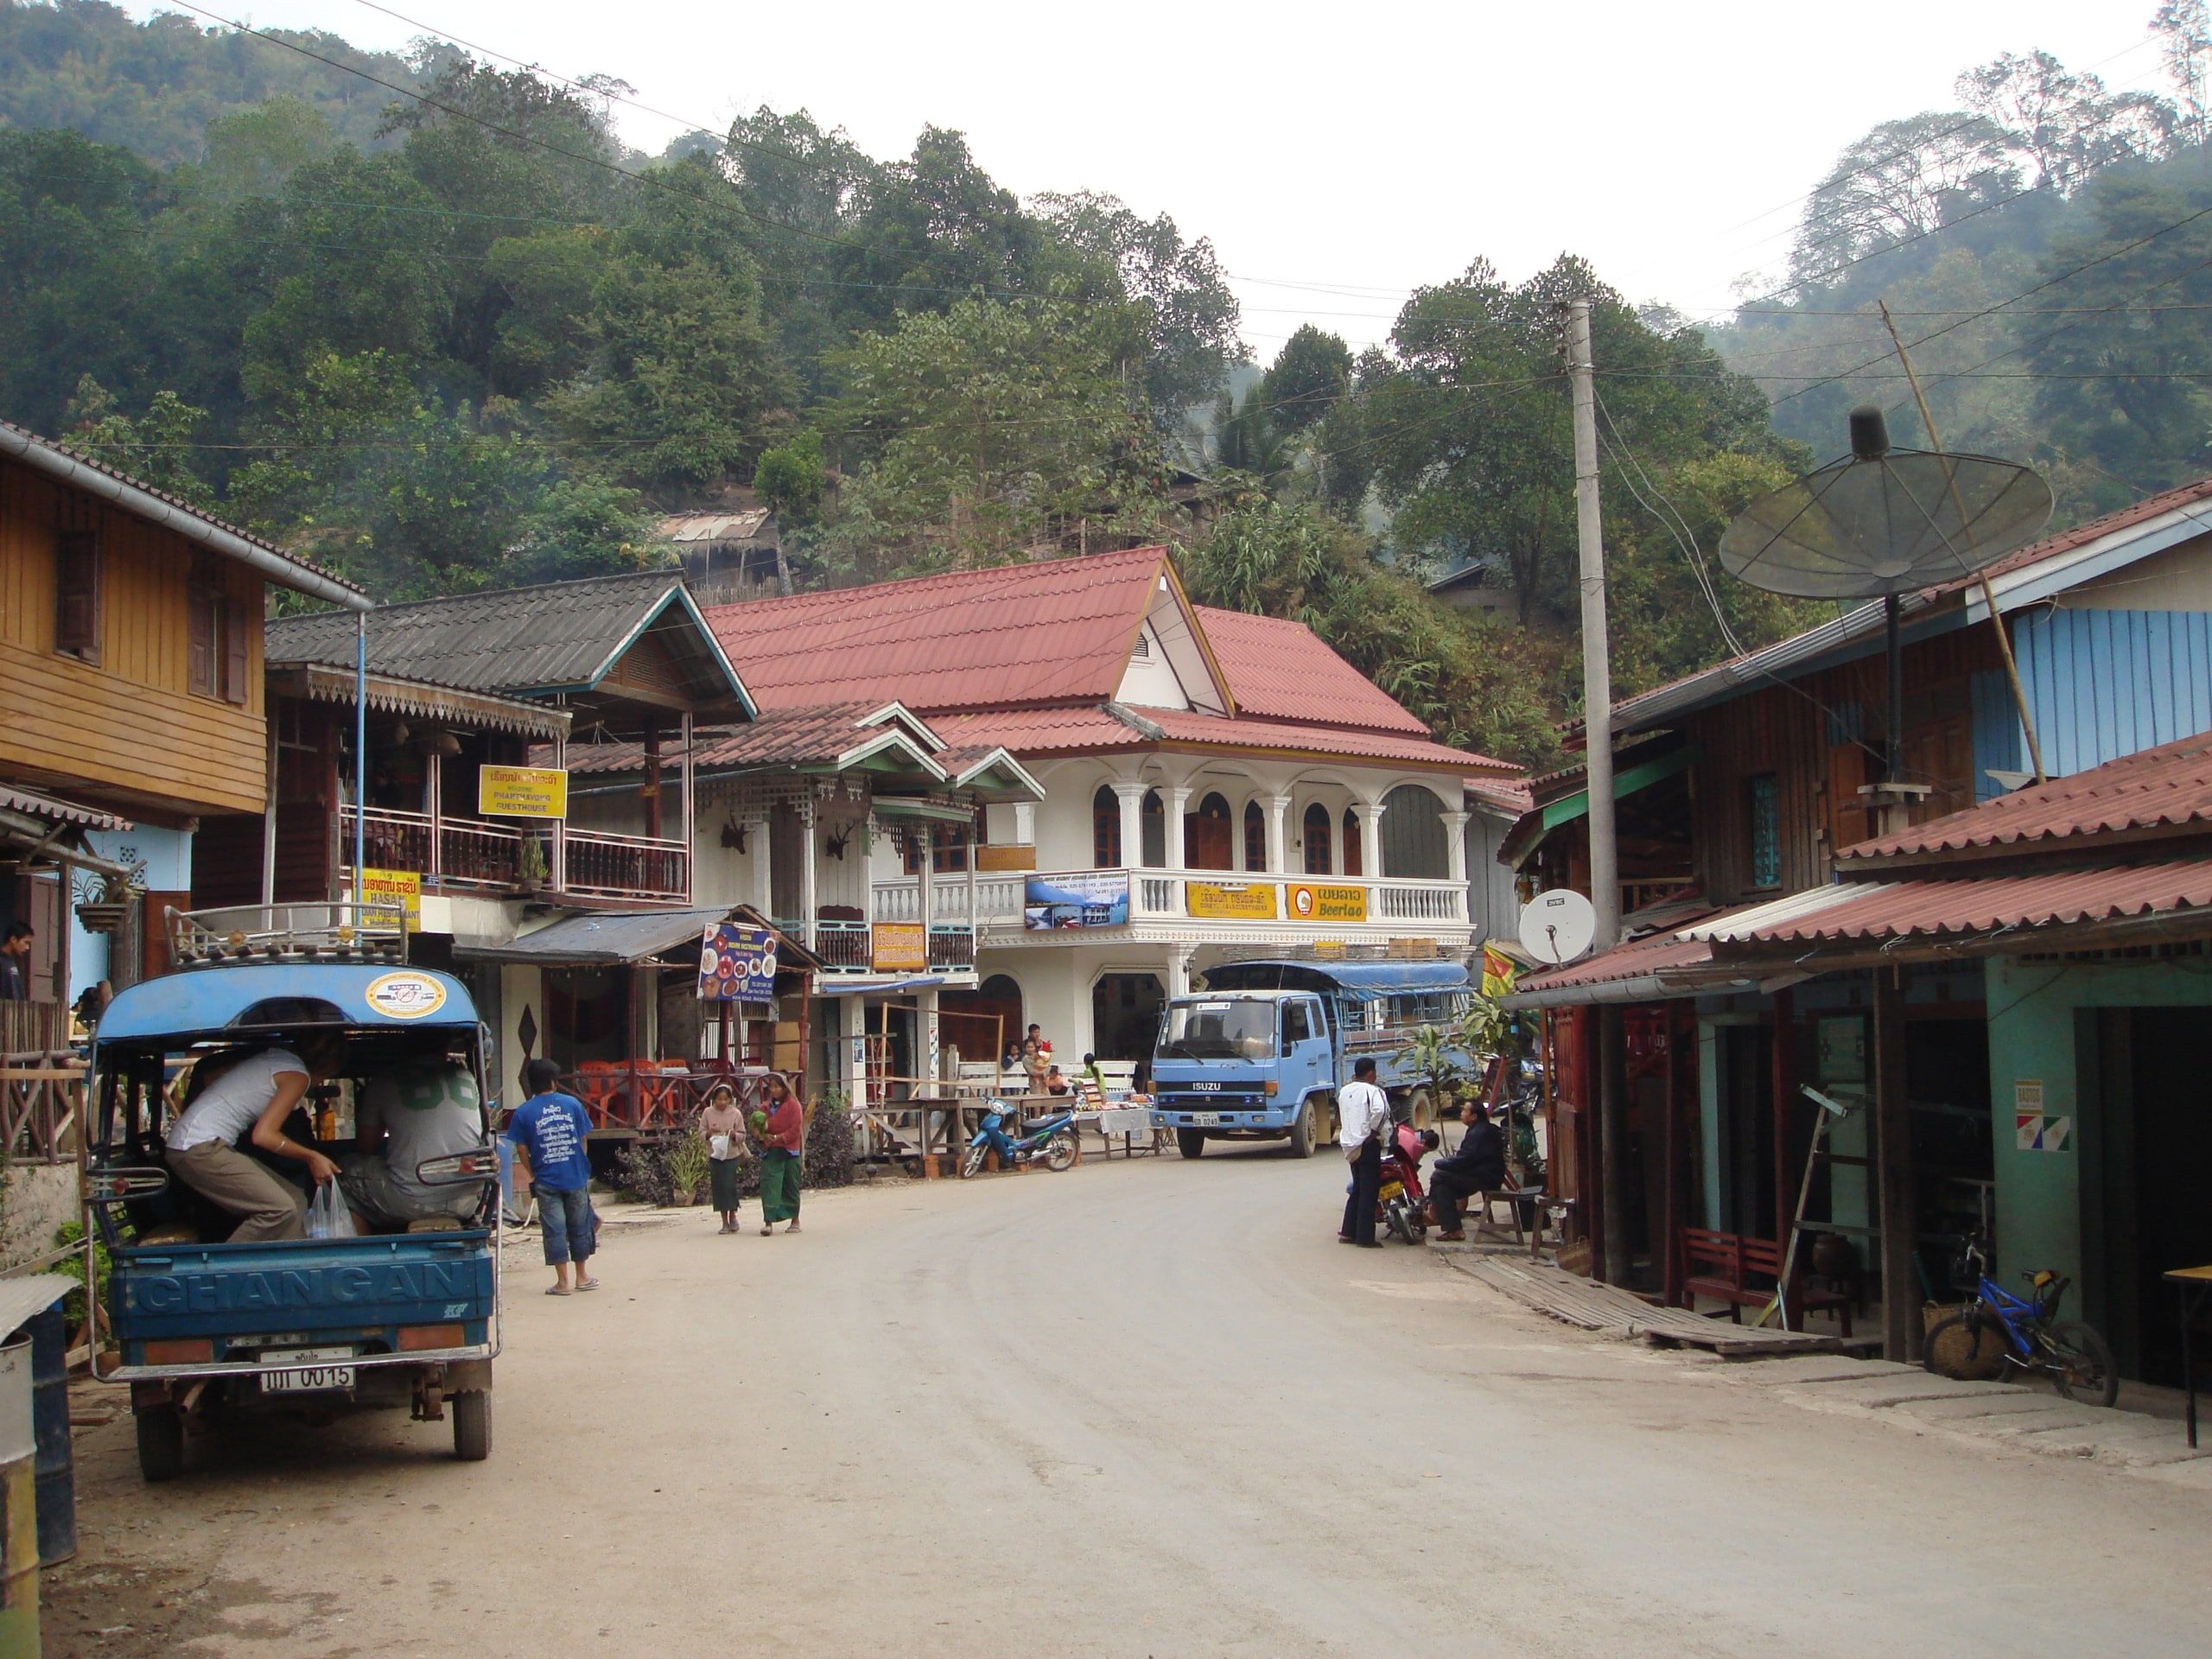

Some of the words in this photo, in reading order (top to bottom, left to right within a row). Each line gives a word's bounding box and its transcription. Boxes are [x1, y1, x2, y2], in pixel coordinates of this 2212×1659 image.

[496, 802, 548, 812] GUESTHOUSE
[1318, 888, 1361, 901] ເບຍລາວ
[1319, 902, 1363, 917] Beerlao
[1192, 1082, 1221, 1091] ISUZU
[137, 1261, 464, 1313] CHANGAN
[301, 1366, 349, 1388] 0015
